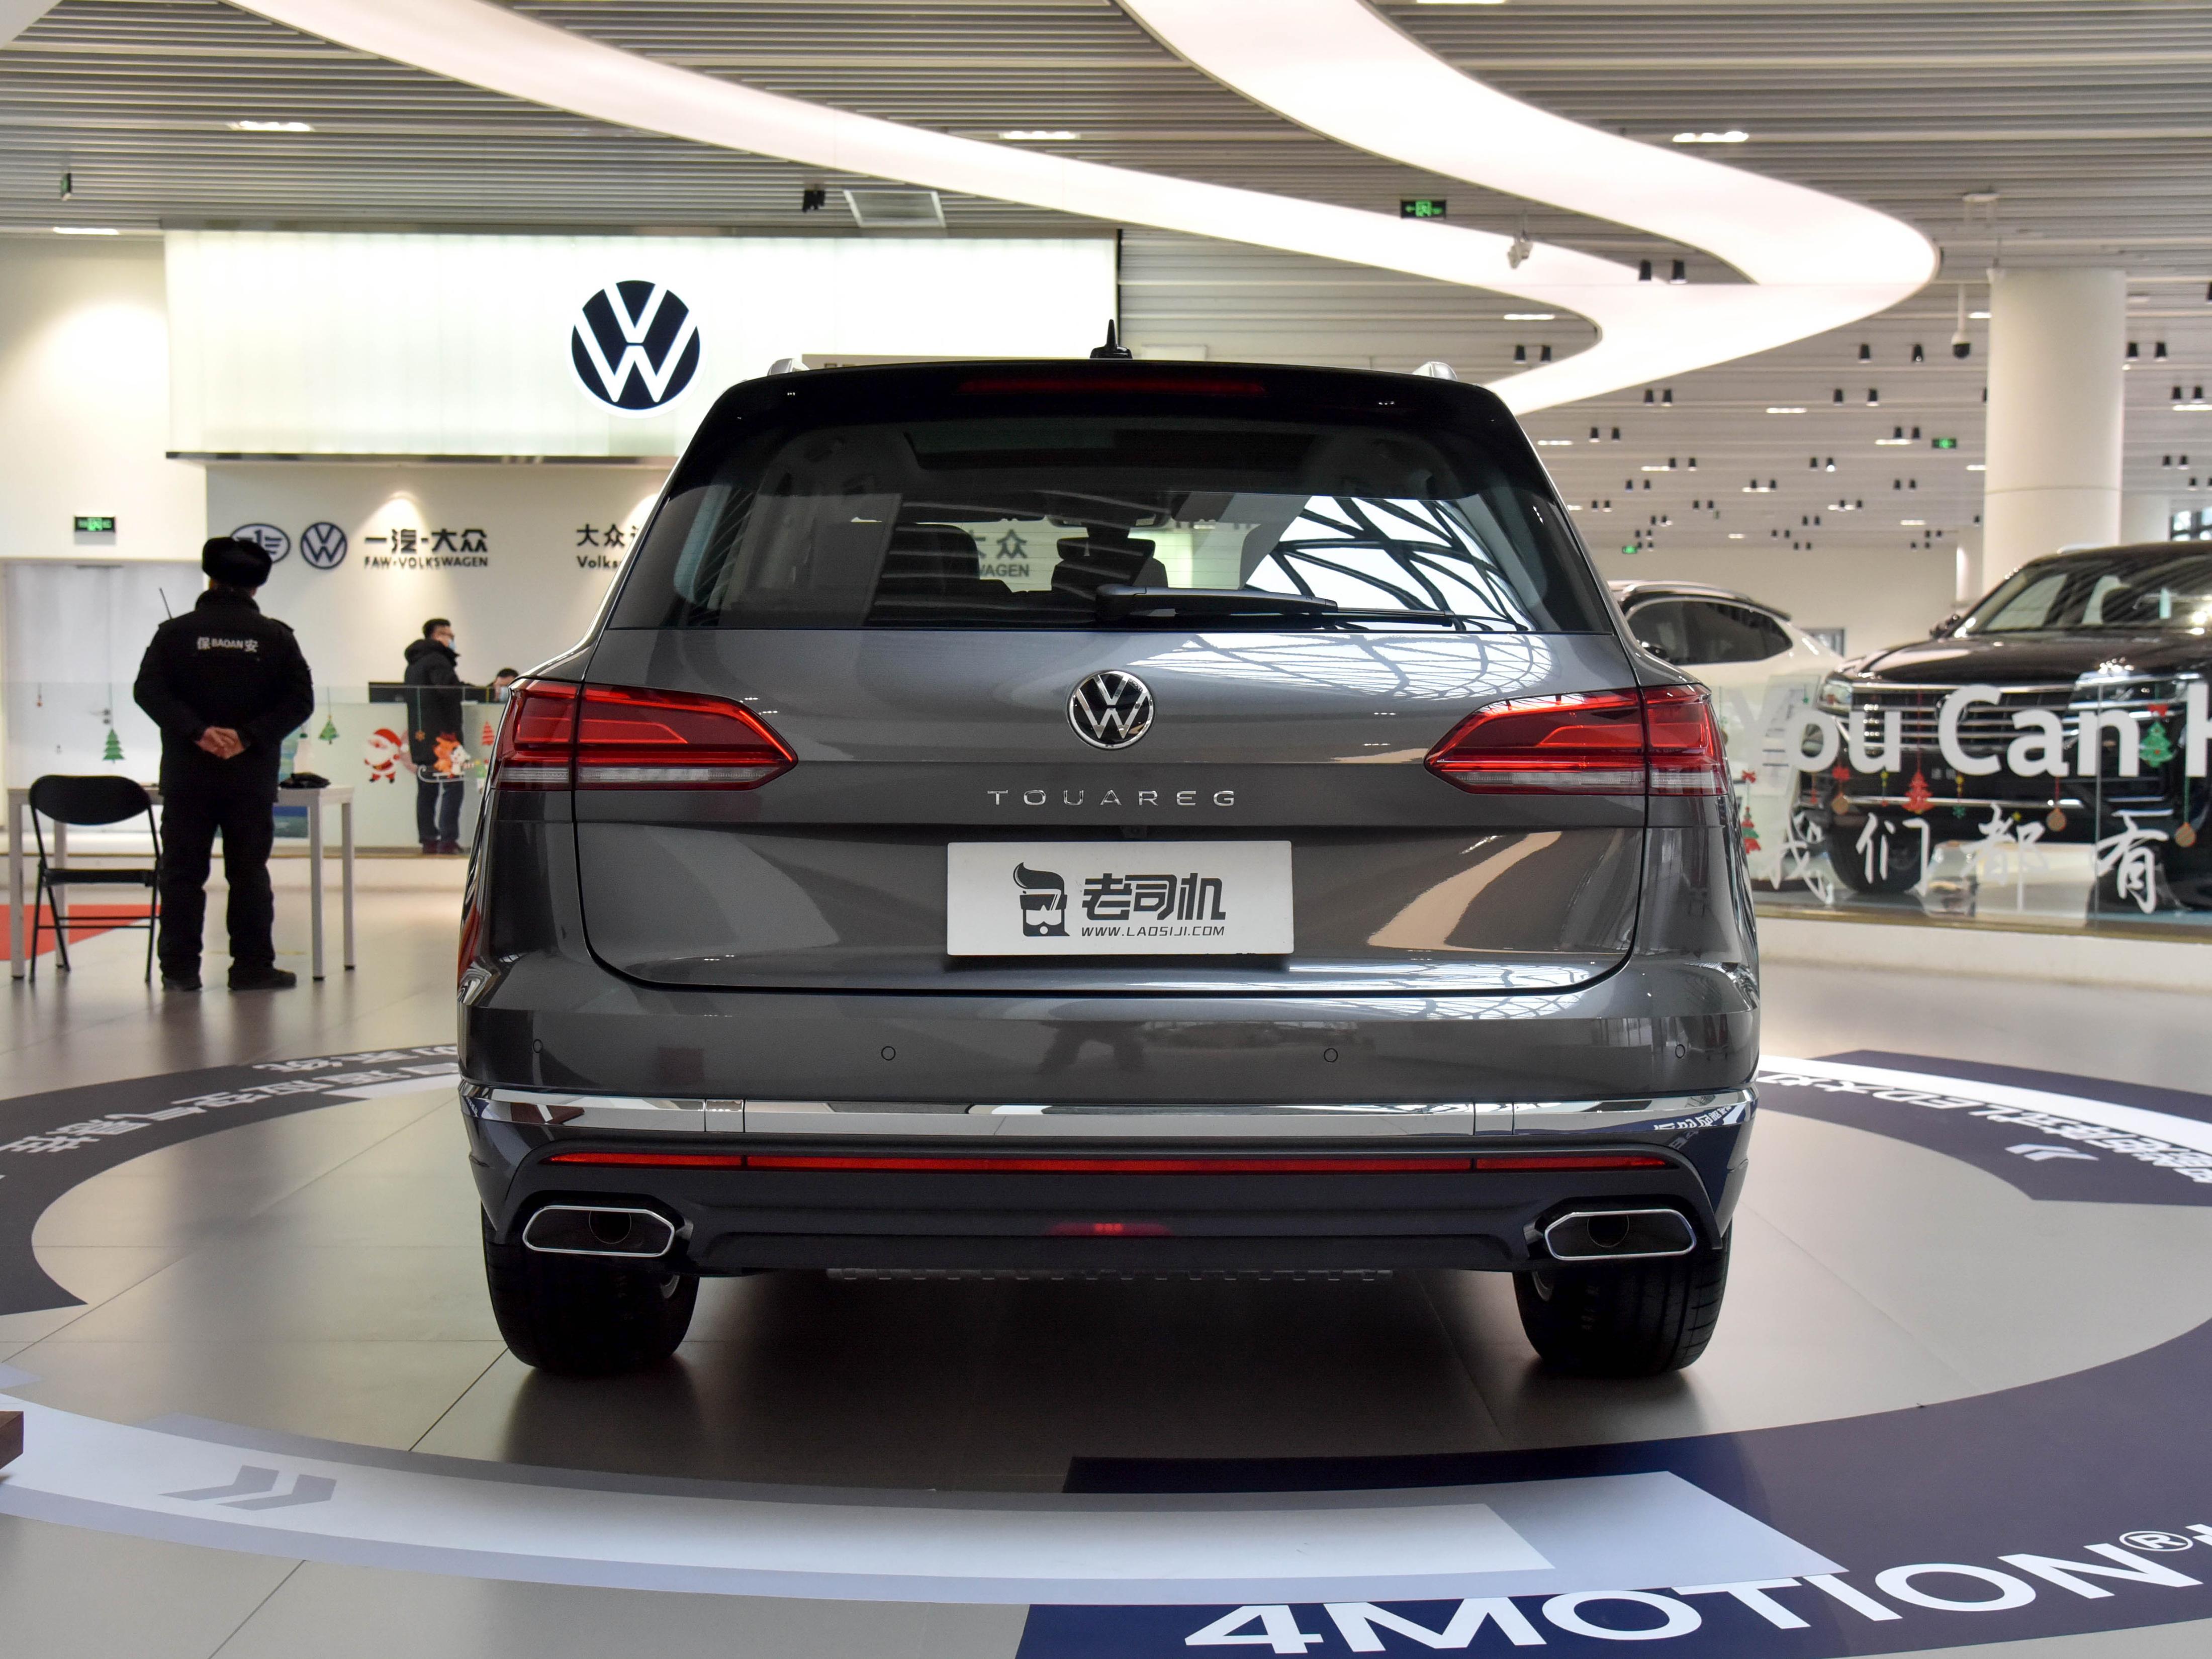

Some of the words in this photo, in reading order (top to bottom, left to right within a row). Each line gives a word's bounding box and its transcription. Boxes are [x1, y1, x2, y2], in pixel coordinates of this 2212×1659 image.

[577, 524, 637, 547] 大众
[577, 555, 621, 568] Volks
[1938, 684, 2140, 777] Can
[987, 790, 1235, 806] TOUAREG
[1082, 873, 1226, 920] 老司机
[1081, 926, 1225, 937] WWW.LAOSIJI.COM
